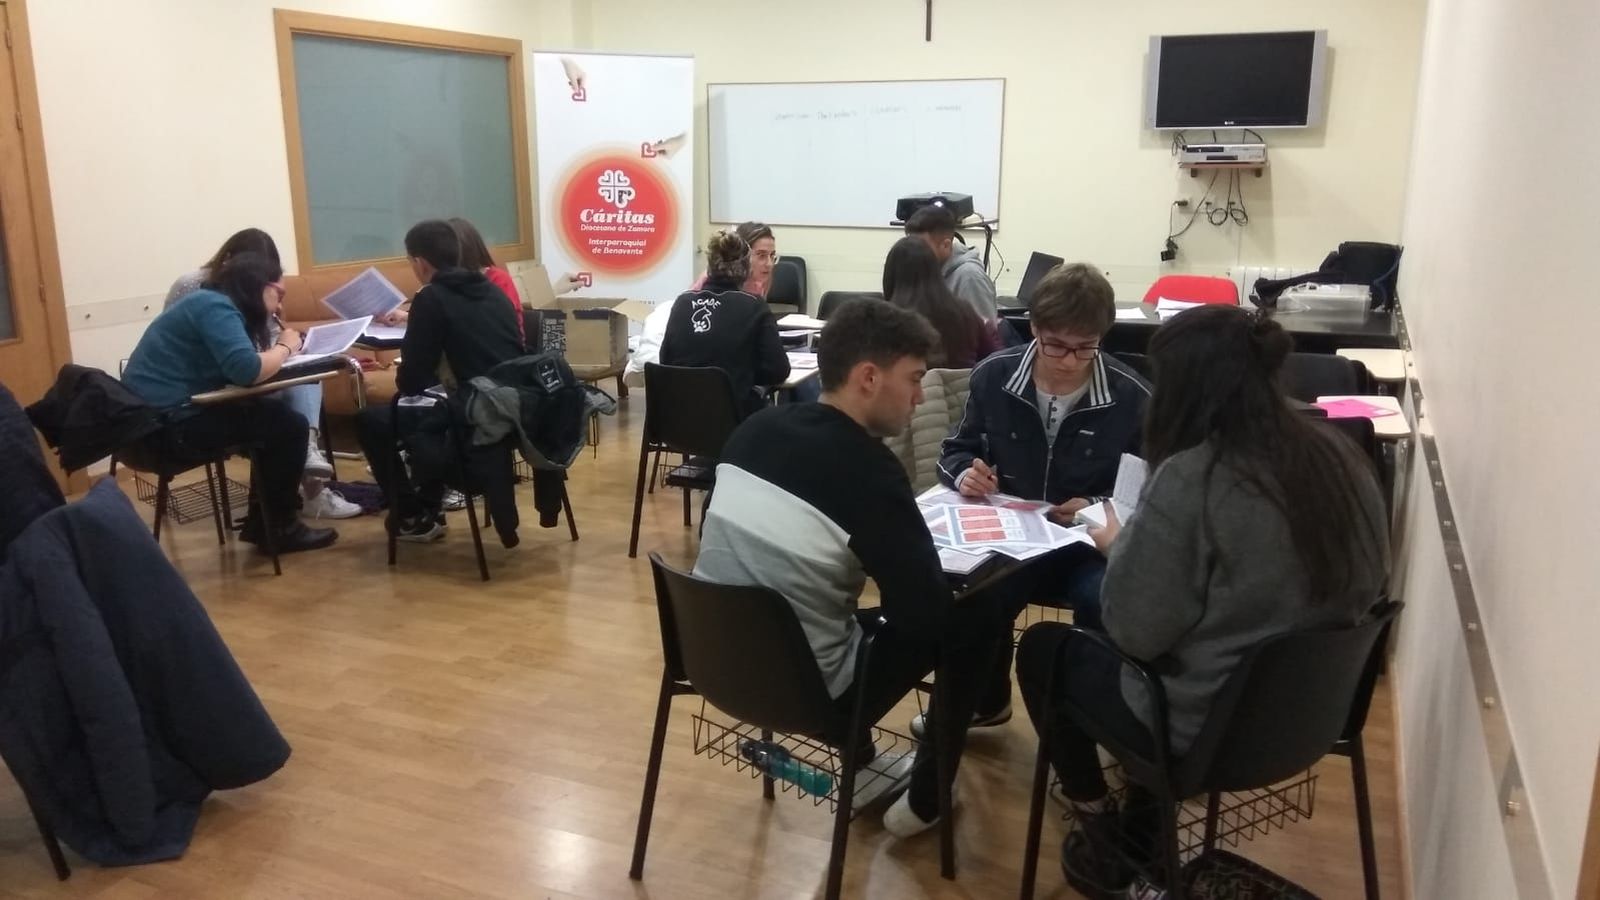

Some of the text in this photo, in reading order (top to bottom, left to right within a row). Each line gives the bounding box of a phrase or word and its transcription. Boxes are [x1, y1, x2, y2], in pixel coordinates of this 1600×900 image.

[580, 208, 655, 224] Cáritas
[580, 224, 616, 232] Diocesana
[627, 225, 655, 233] Zamora
[588, 238, 647, 248] Interparroquial
[592, 246, 643, 255] de Benavente
